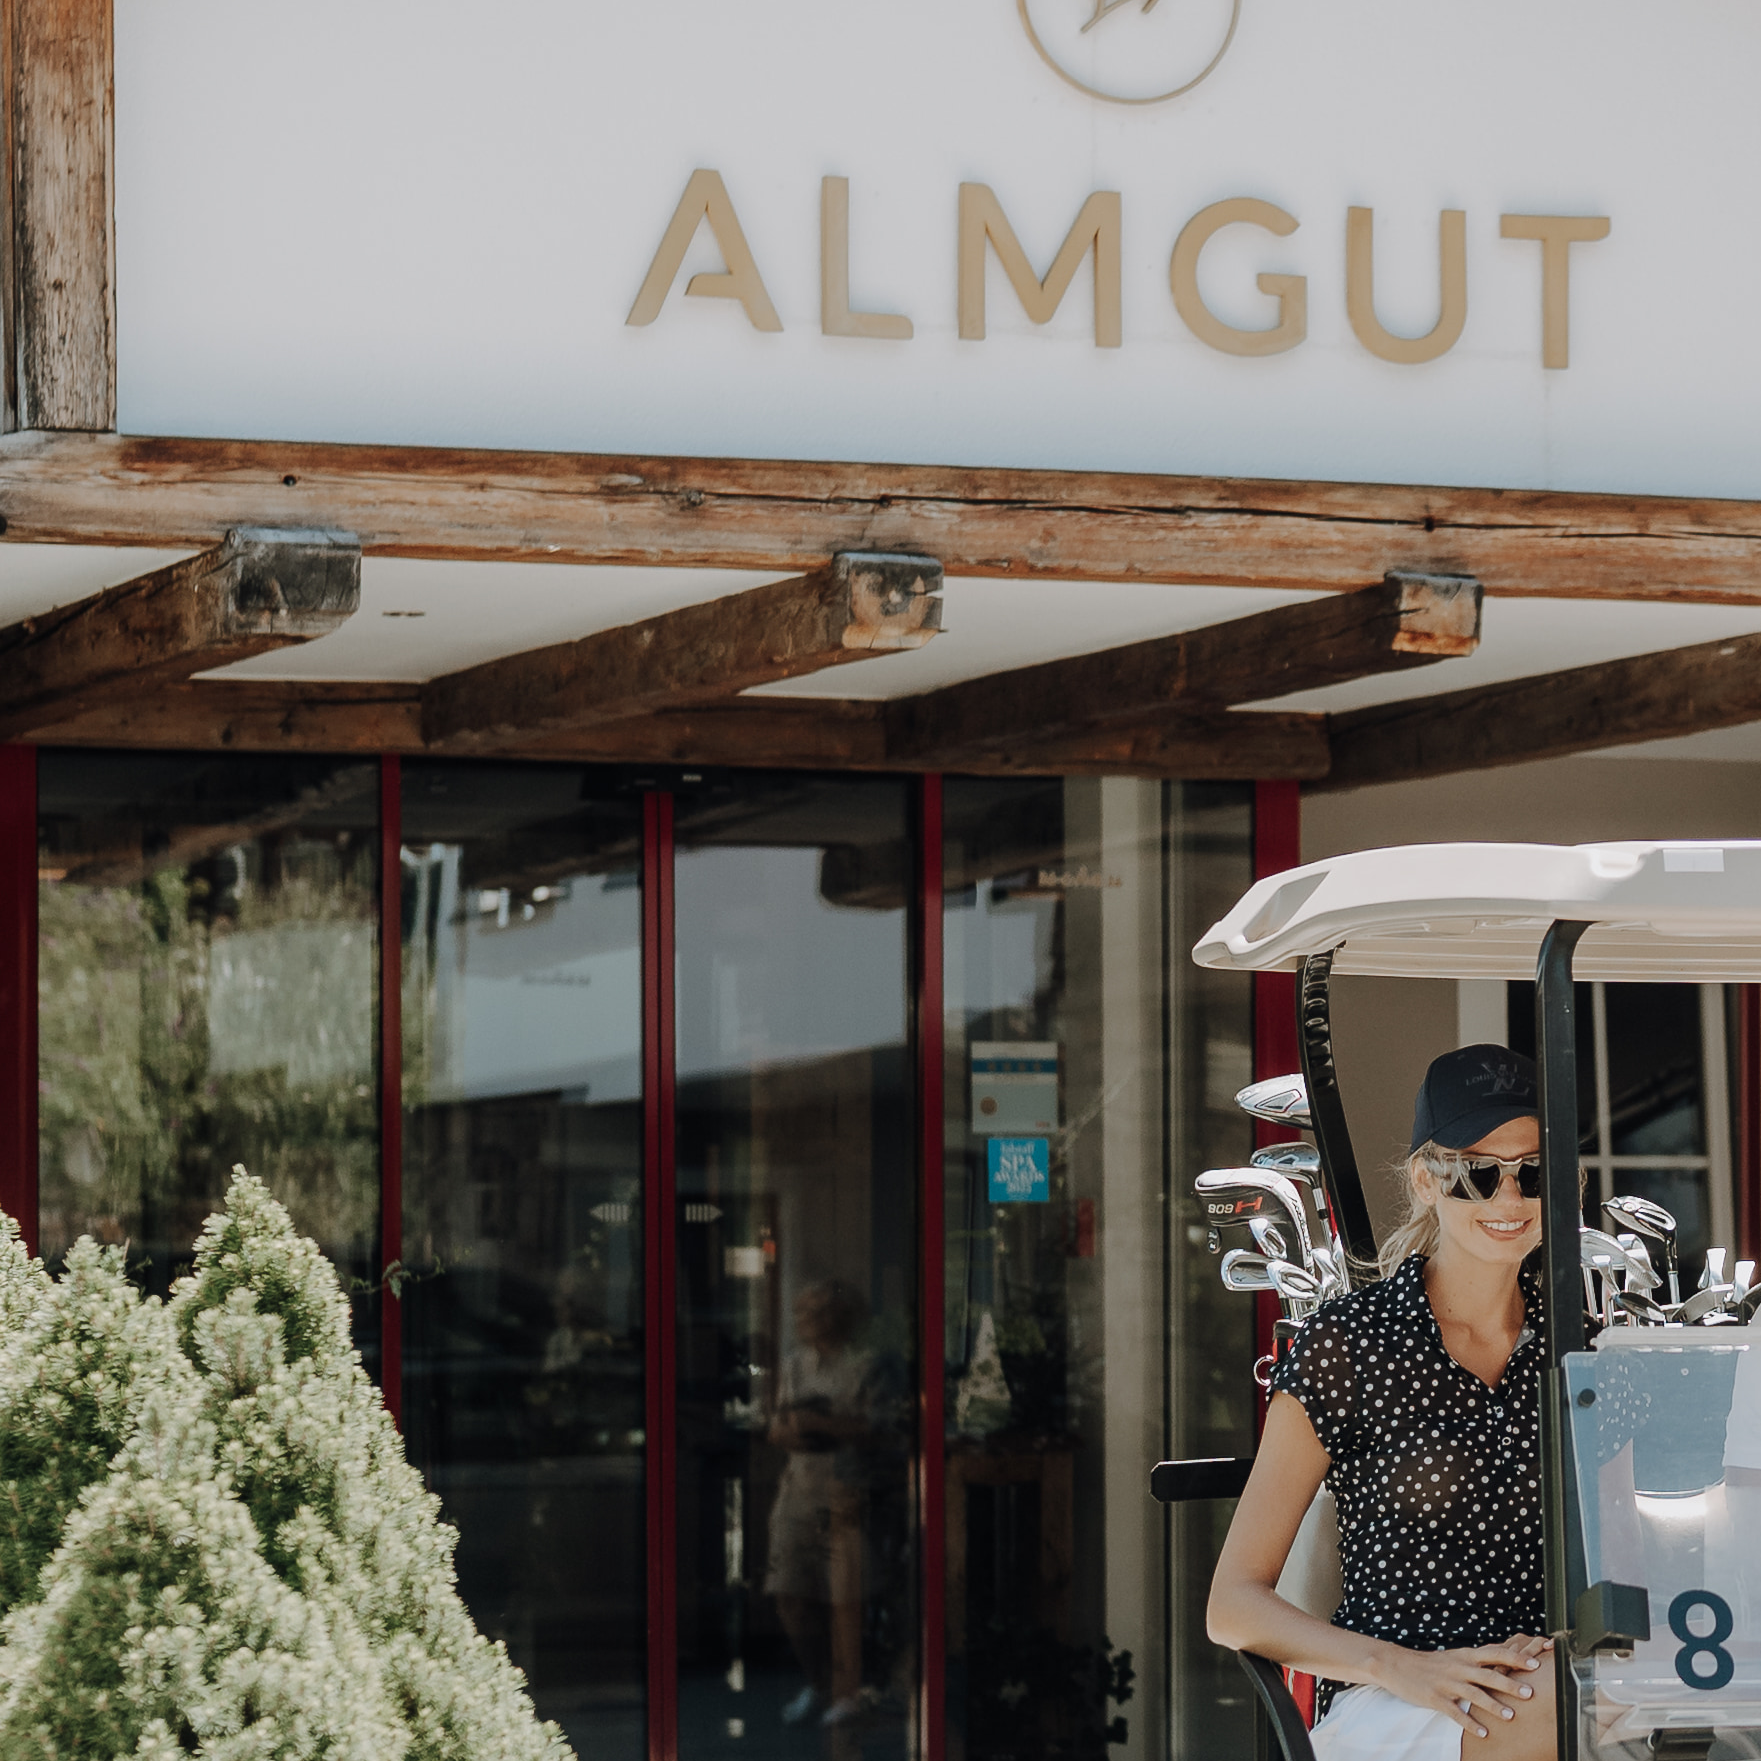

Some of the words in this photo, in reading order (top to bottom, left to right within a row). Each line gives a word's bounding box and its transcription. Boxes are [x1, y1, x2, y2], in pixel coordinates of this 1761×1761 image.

[624, 167, 1612, 370] ALMGUT
[1000, 1155, 1038, 1171] SPA
[1668, 1589, 1735, 1691] 8
